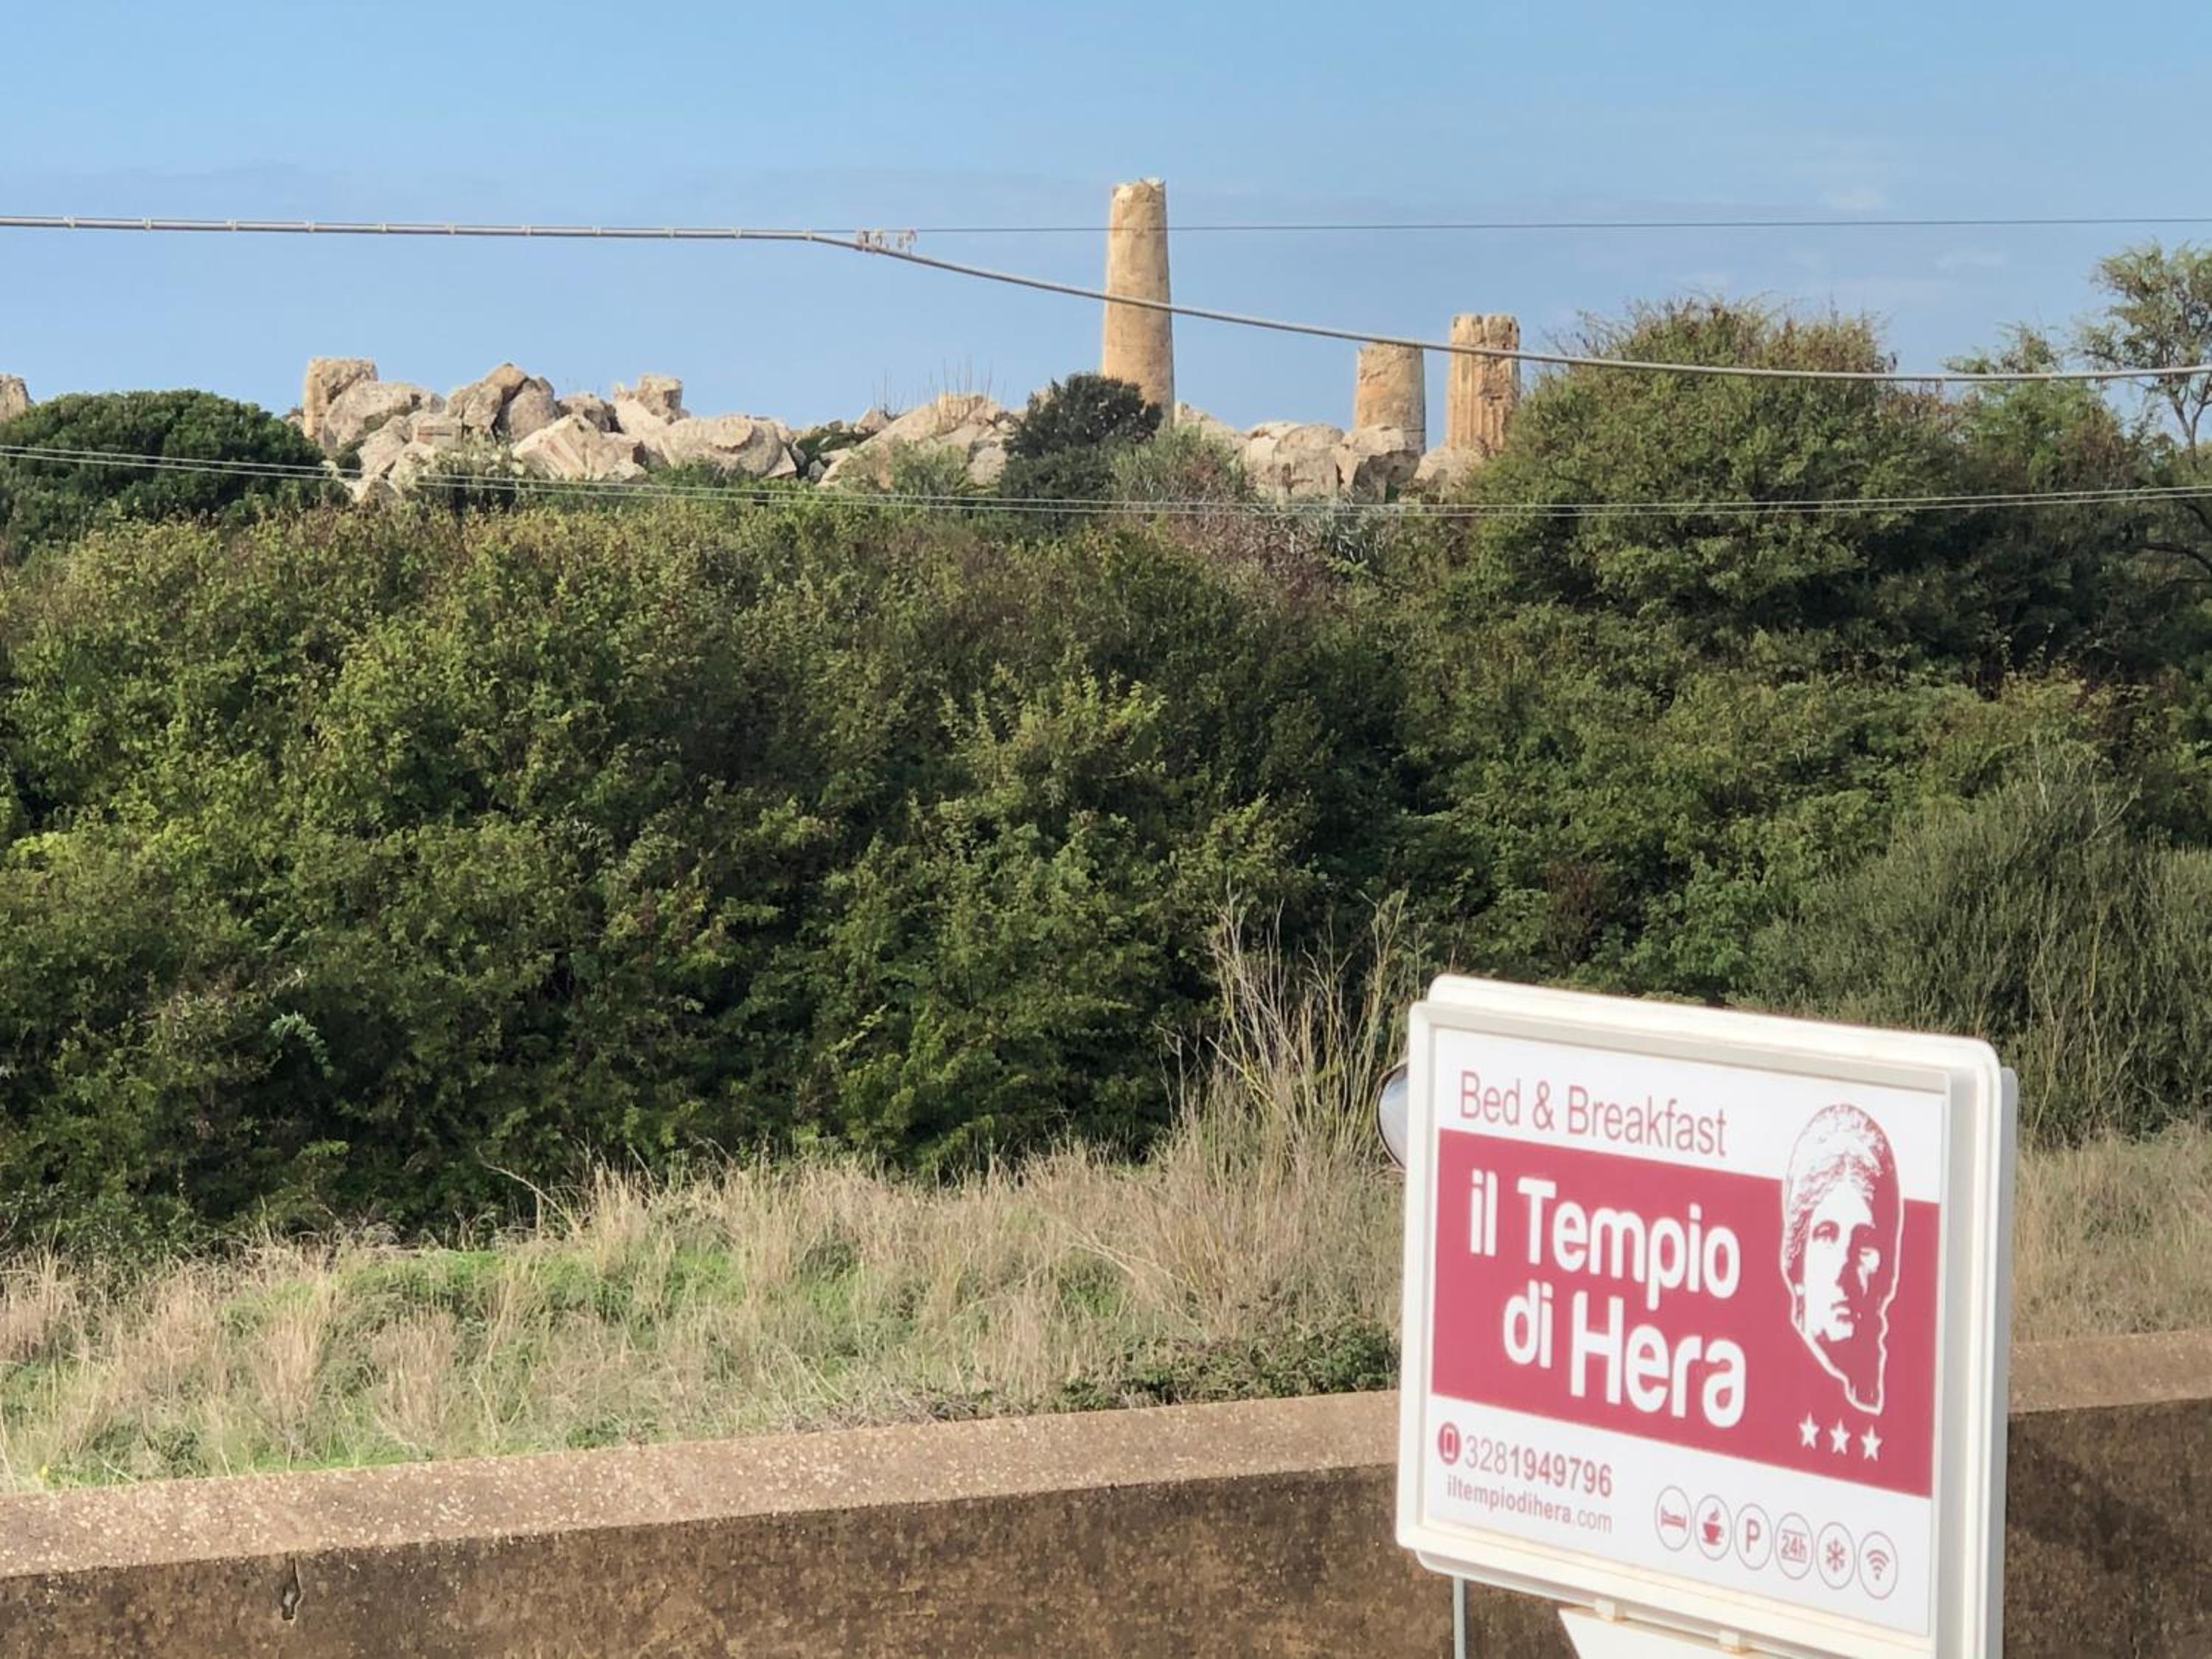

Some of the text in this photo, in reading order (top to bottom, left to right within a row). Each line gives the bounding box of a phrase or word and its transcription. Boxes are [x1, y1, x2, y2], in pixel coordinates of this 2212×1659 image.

[1461, 1070, 1727, 1157] Bed & Breakfast
[1470, 1168, 1741, 1312] il Tempio
[1503, 1279, 1747, 1429] di Hera
[1464, 1435, 1613, 1498] 3281949796
[1447, 1474, 1613, 1534] iltempiodihera.com
[1745, 1518, 1761, 1554] P
[1781, 1534, 1806, 1559] 24h
